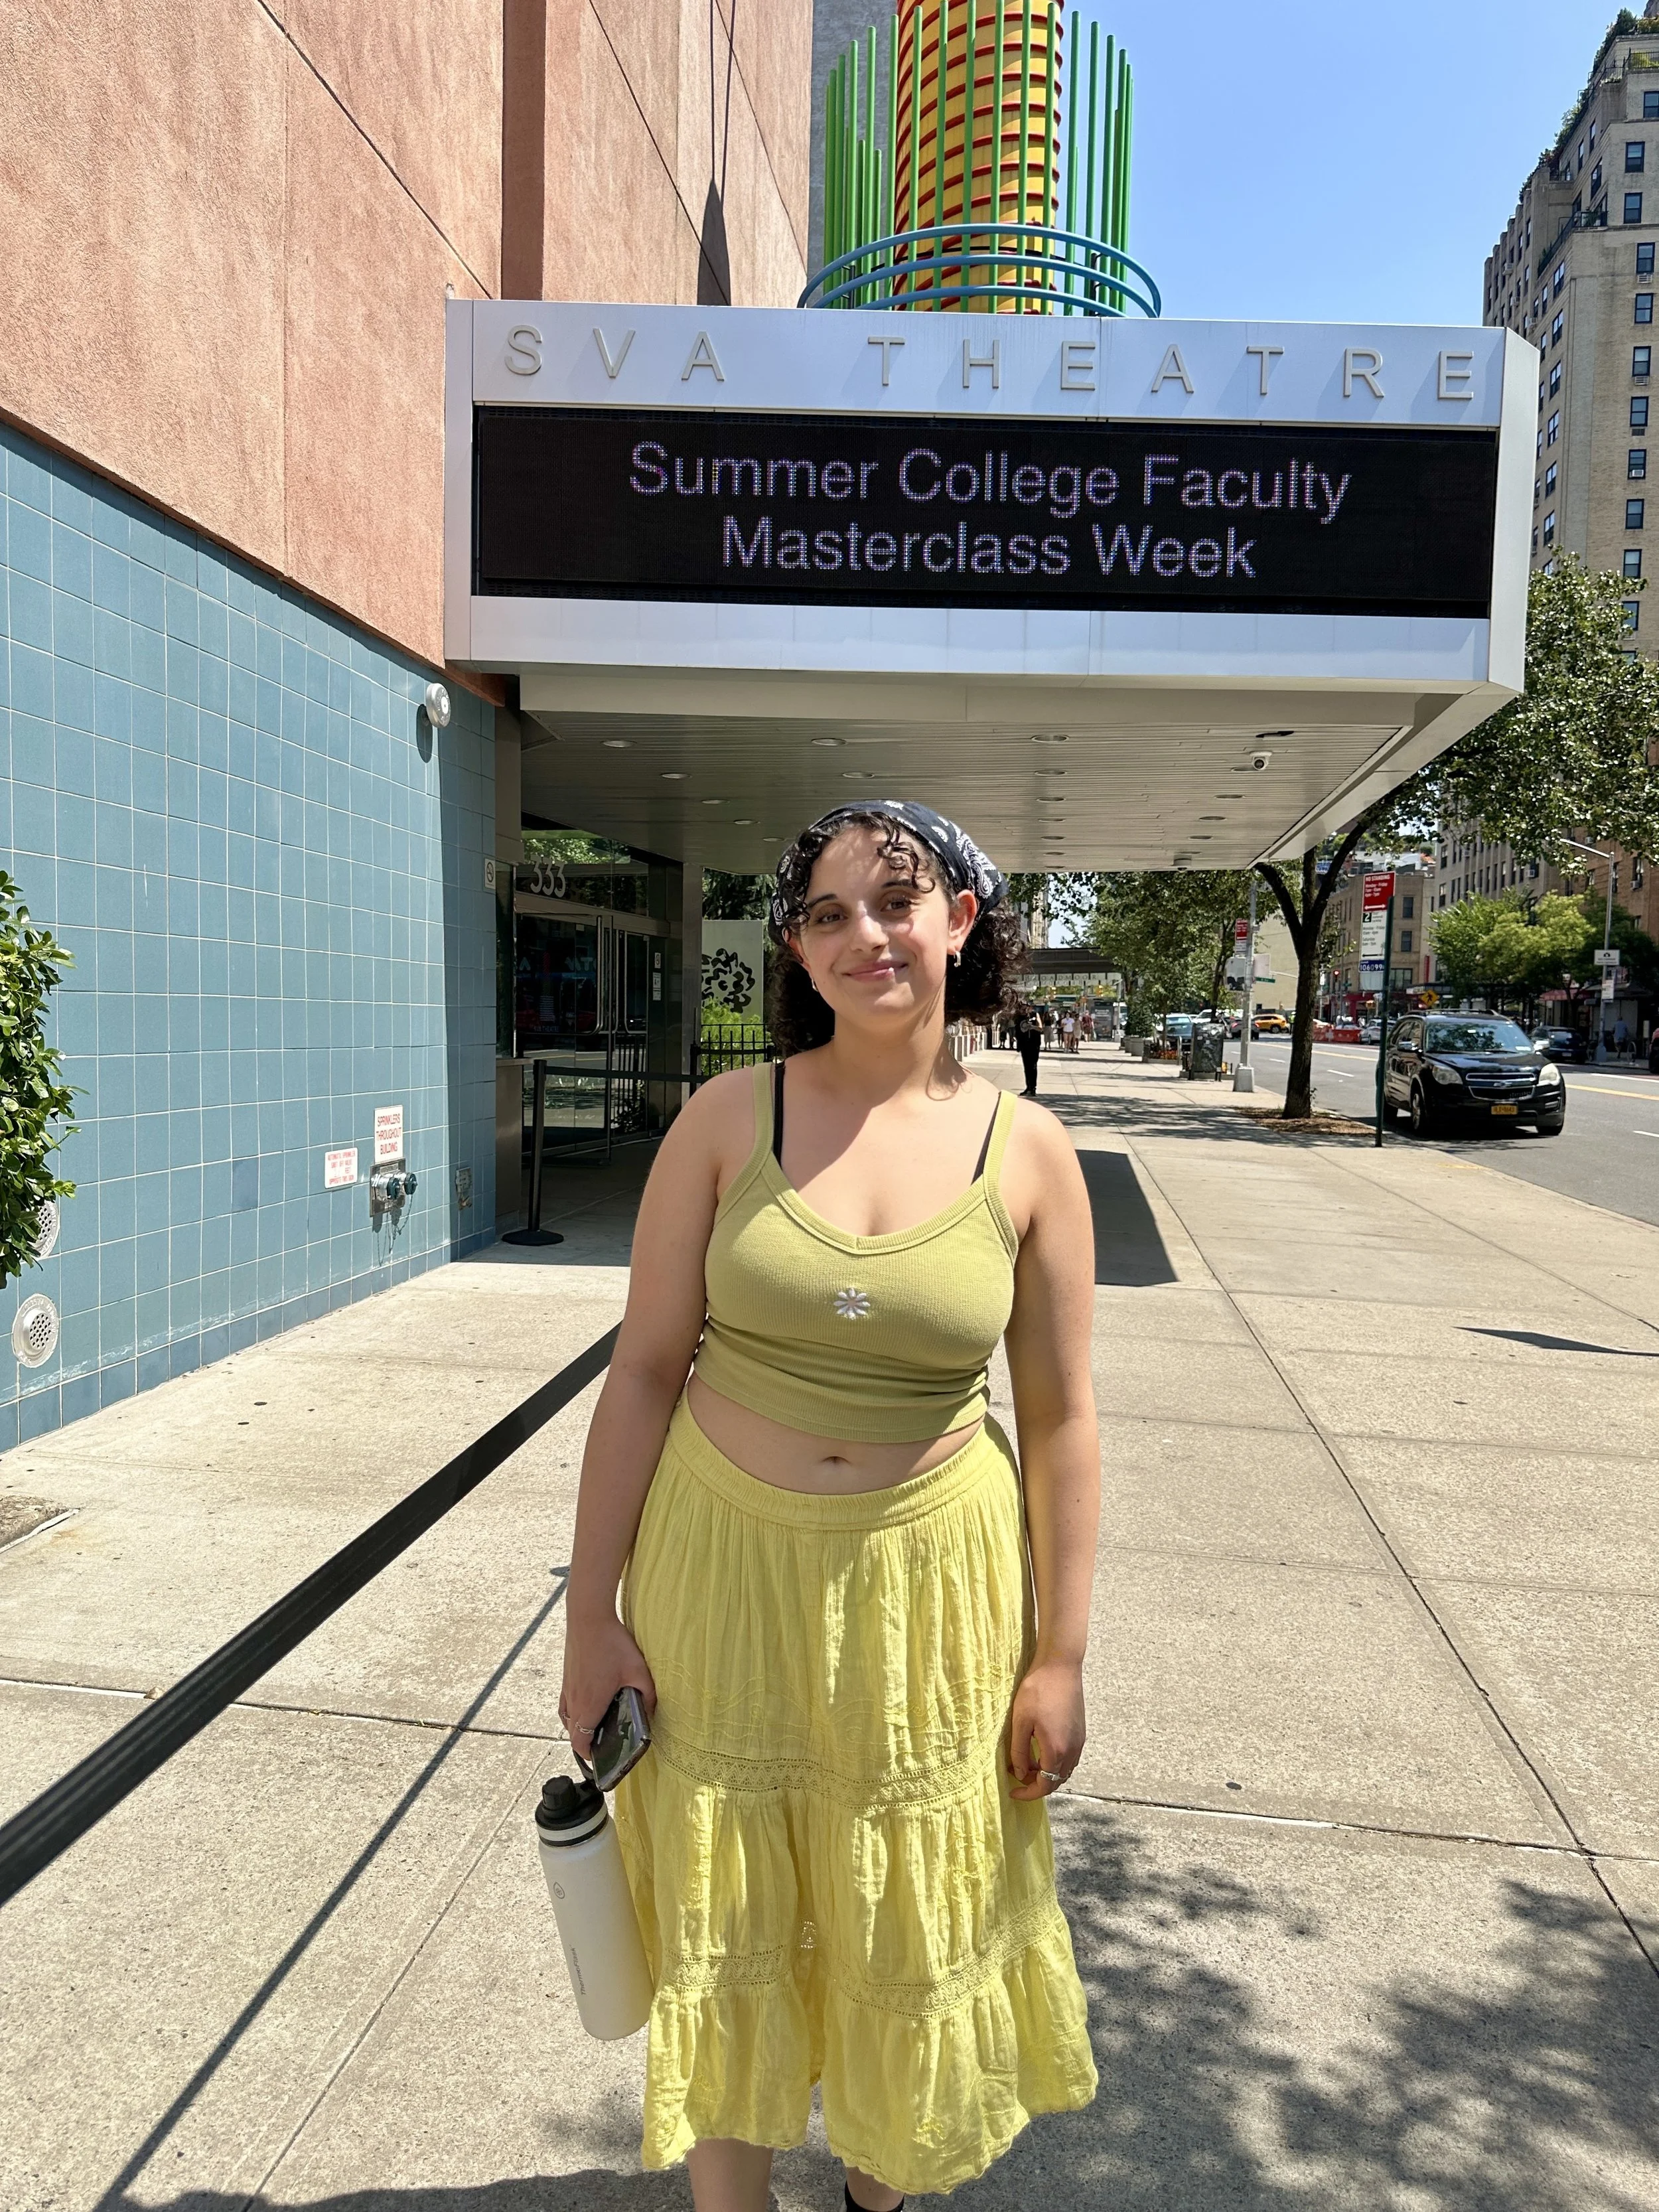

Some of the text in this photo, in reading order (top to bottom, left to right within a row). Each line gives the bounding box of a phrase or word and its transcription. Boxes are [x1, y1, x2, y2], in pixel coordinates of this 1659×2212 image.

[504, 324, 1474, 400] SVA THEATRE
[630, 441, 1352, 525] Summer College Faculty
[723, 516, 1257, 578] Masterclass Week
[530, 853, 566, 898] 333
[1364, 913, 1370, 922] 2
[376, 1128, 401, 1141] THROUGHOUT
[378, 1113, 400, 1127] SPRINKLERS
[380, 1141, 398, 1155] BUILDING
